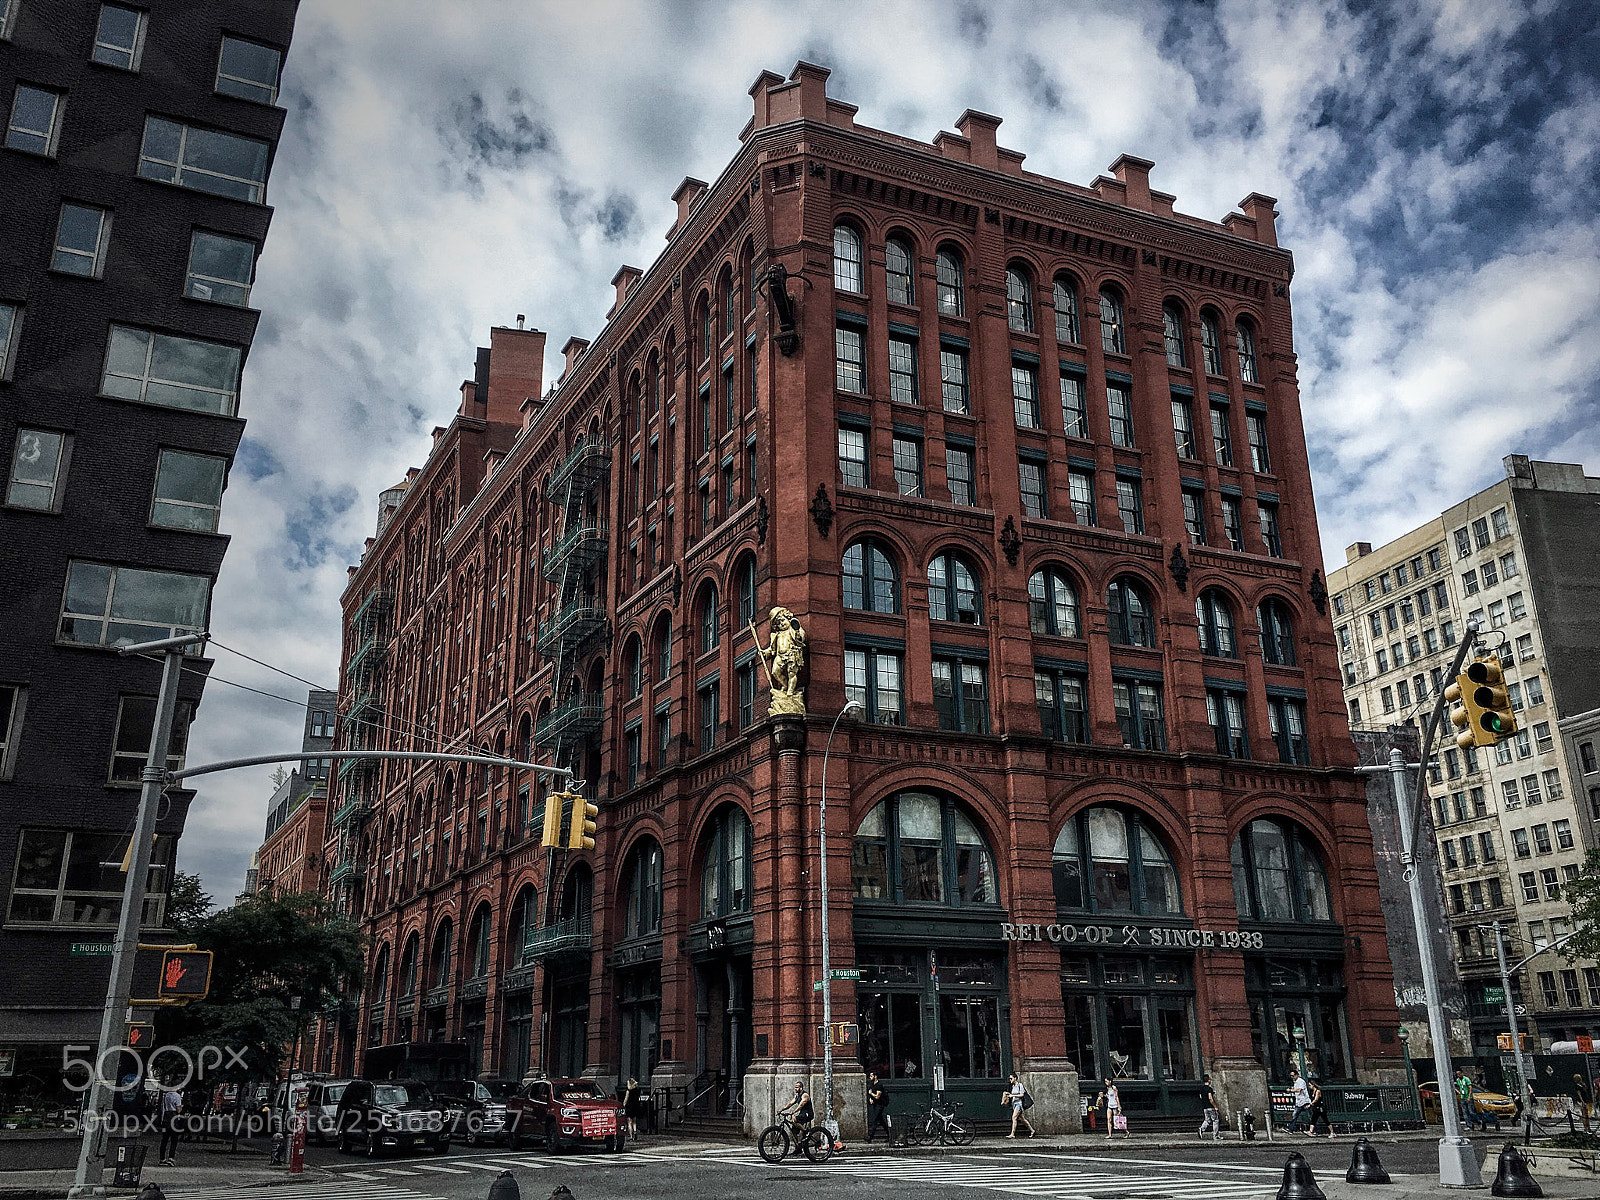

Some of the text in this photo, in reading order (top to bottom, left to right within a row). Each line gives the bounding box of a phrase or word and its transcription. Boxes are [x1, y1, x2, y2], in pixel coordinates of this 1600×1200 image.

[1000, 922, 1264, 950] REI CO-OP SINCE 1938
[79, 944, 112, 952] Houston
[835, 969, 860, 977] Houston
[1344, 1092, 1365, 1100] Subway
